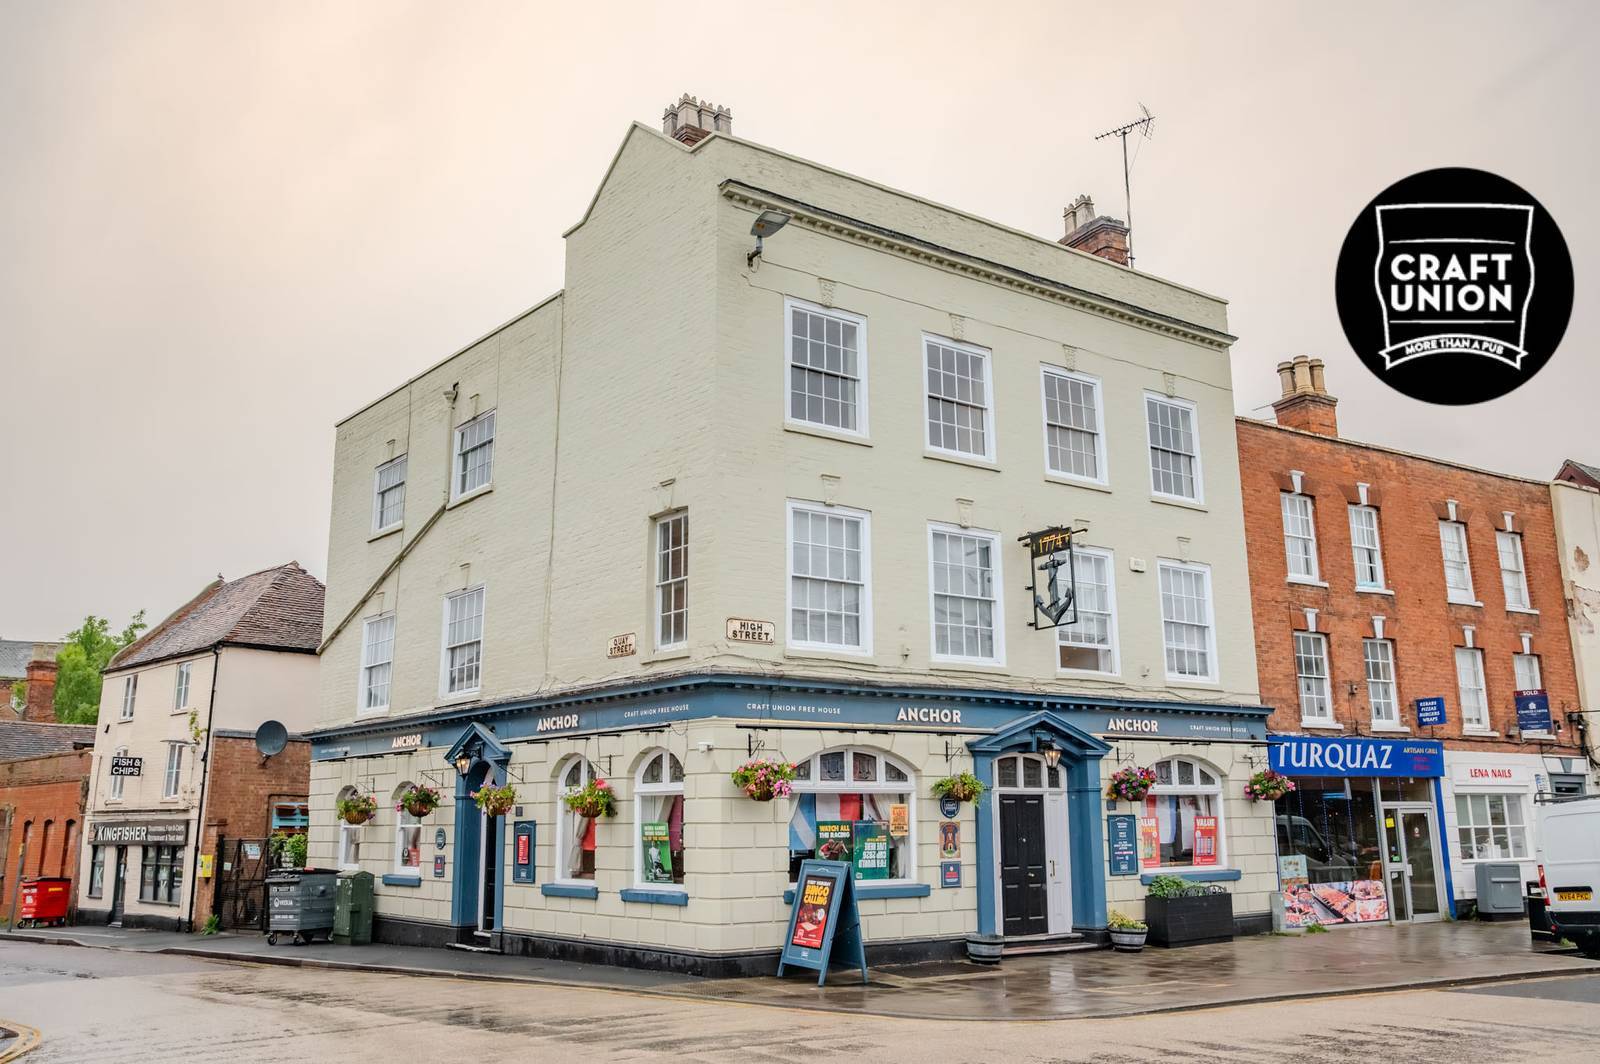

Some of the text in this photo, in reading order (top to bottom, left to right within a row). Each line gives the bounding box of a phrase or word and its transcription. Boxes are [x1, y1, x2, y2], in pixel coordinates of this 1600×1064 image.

[739, 621, 763, 632] HIGH
[613, 635, 629, 648] QUAY
[624, 710, 639, 719] CRAFT
[640, 708, 657, 716] UNION
[671, 704, 689, 712] HOUSE
[747, 703, 841, 715] CRAFT UNION FREE HOUSE
[896, 707, 962, 724] ANCHOR
[536, 714, 579, 732] ANCHOR
[1108, 718, 1159, 733] ANCHOR
[391, 734, 422, 749] ANCHOR
[112, 758, 141, 767] FISH &
[1275, 742, 1393, 772] TURQUAZ
[112, 767, 139, 776] CHIPS
[1470, 768, 1512, 778] LENA NAILS
[1196, 818, 1215, 826] VALUE
[98, 826, 147, 841] KINGFISHER
[805, 885, 830, 896] BINGO
[803, 895, 828, 905] CALLING
